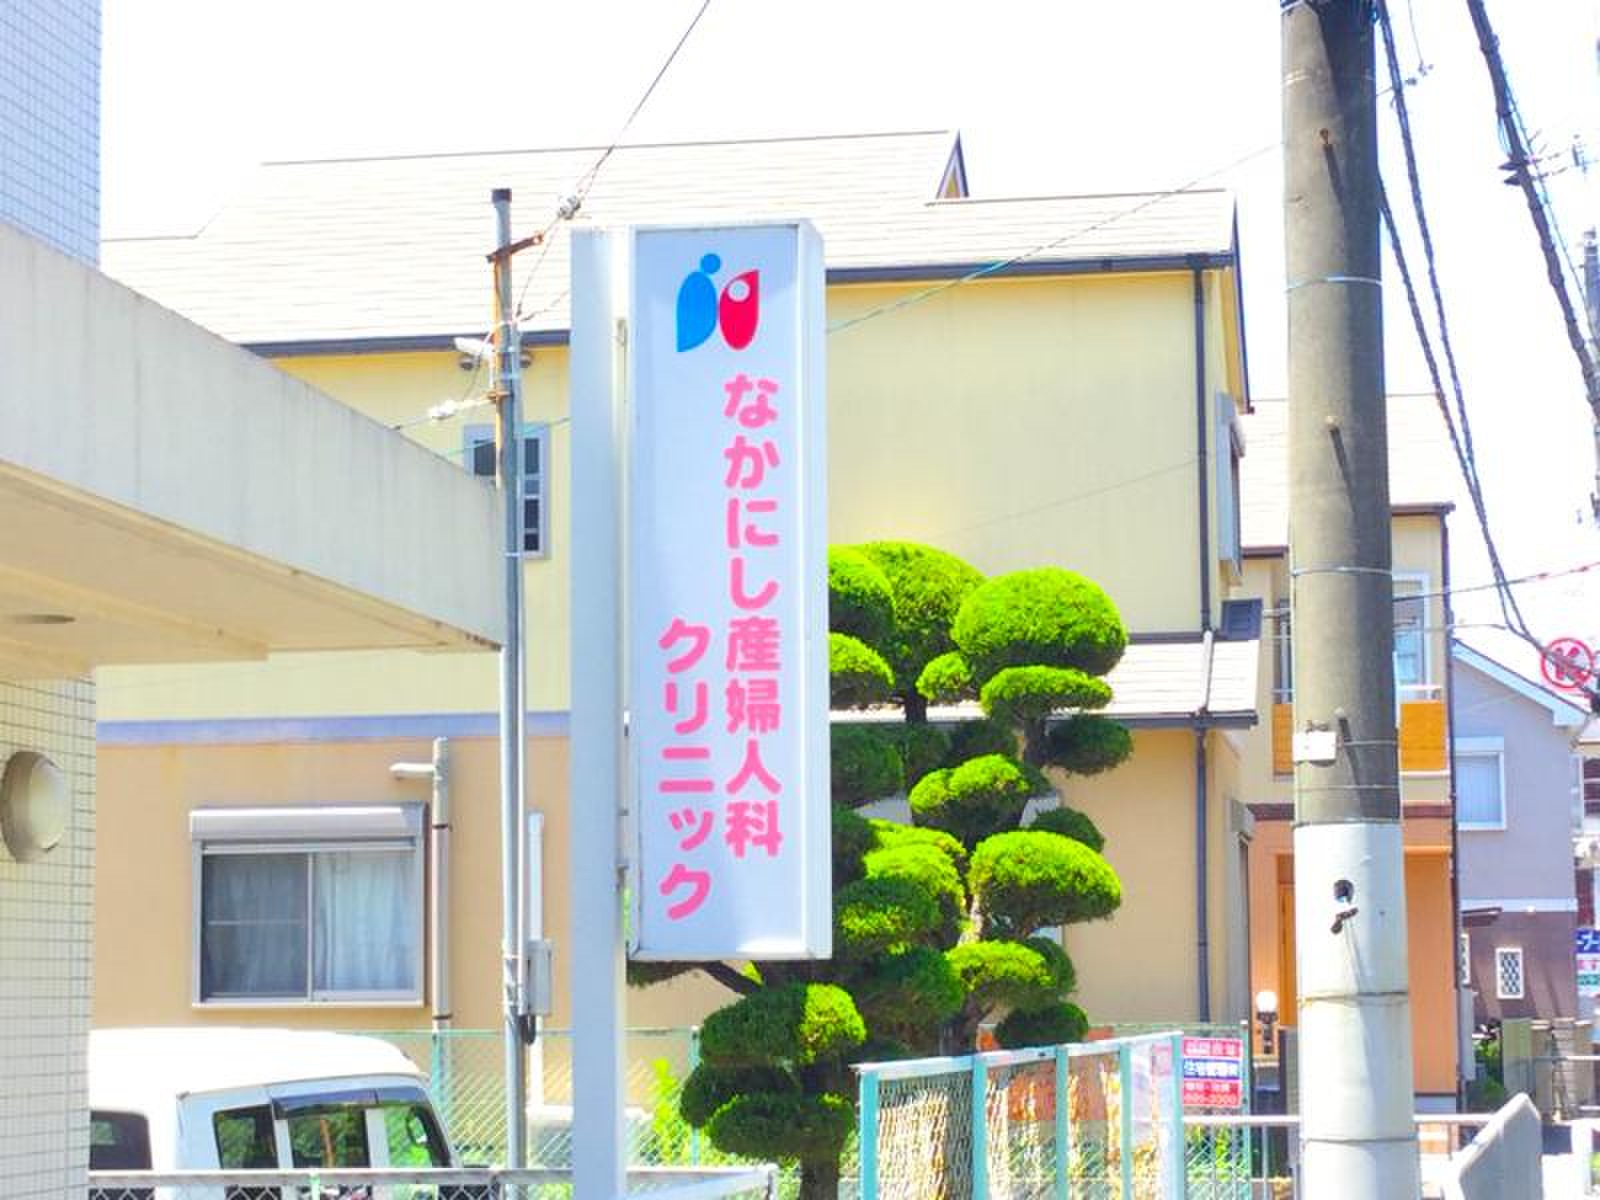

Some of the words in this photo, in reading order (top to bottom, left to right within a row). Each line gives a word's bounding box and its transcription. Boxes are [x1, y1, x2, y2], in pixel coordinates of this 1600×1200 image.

[658, 617, 713, 921] クリニック
[723, 373, 783, 859] なかにし産婦人科
